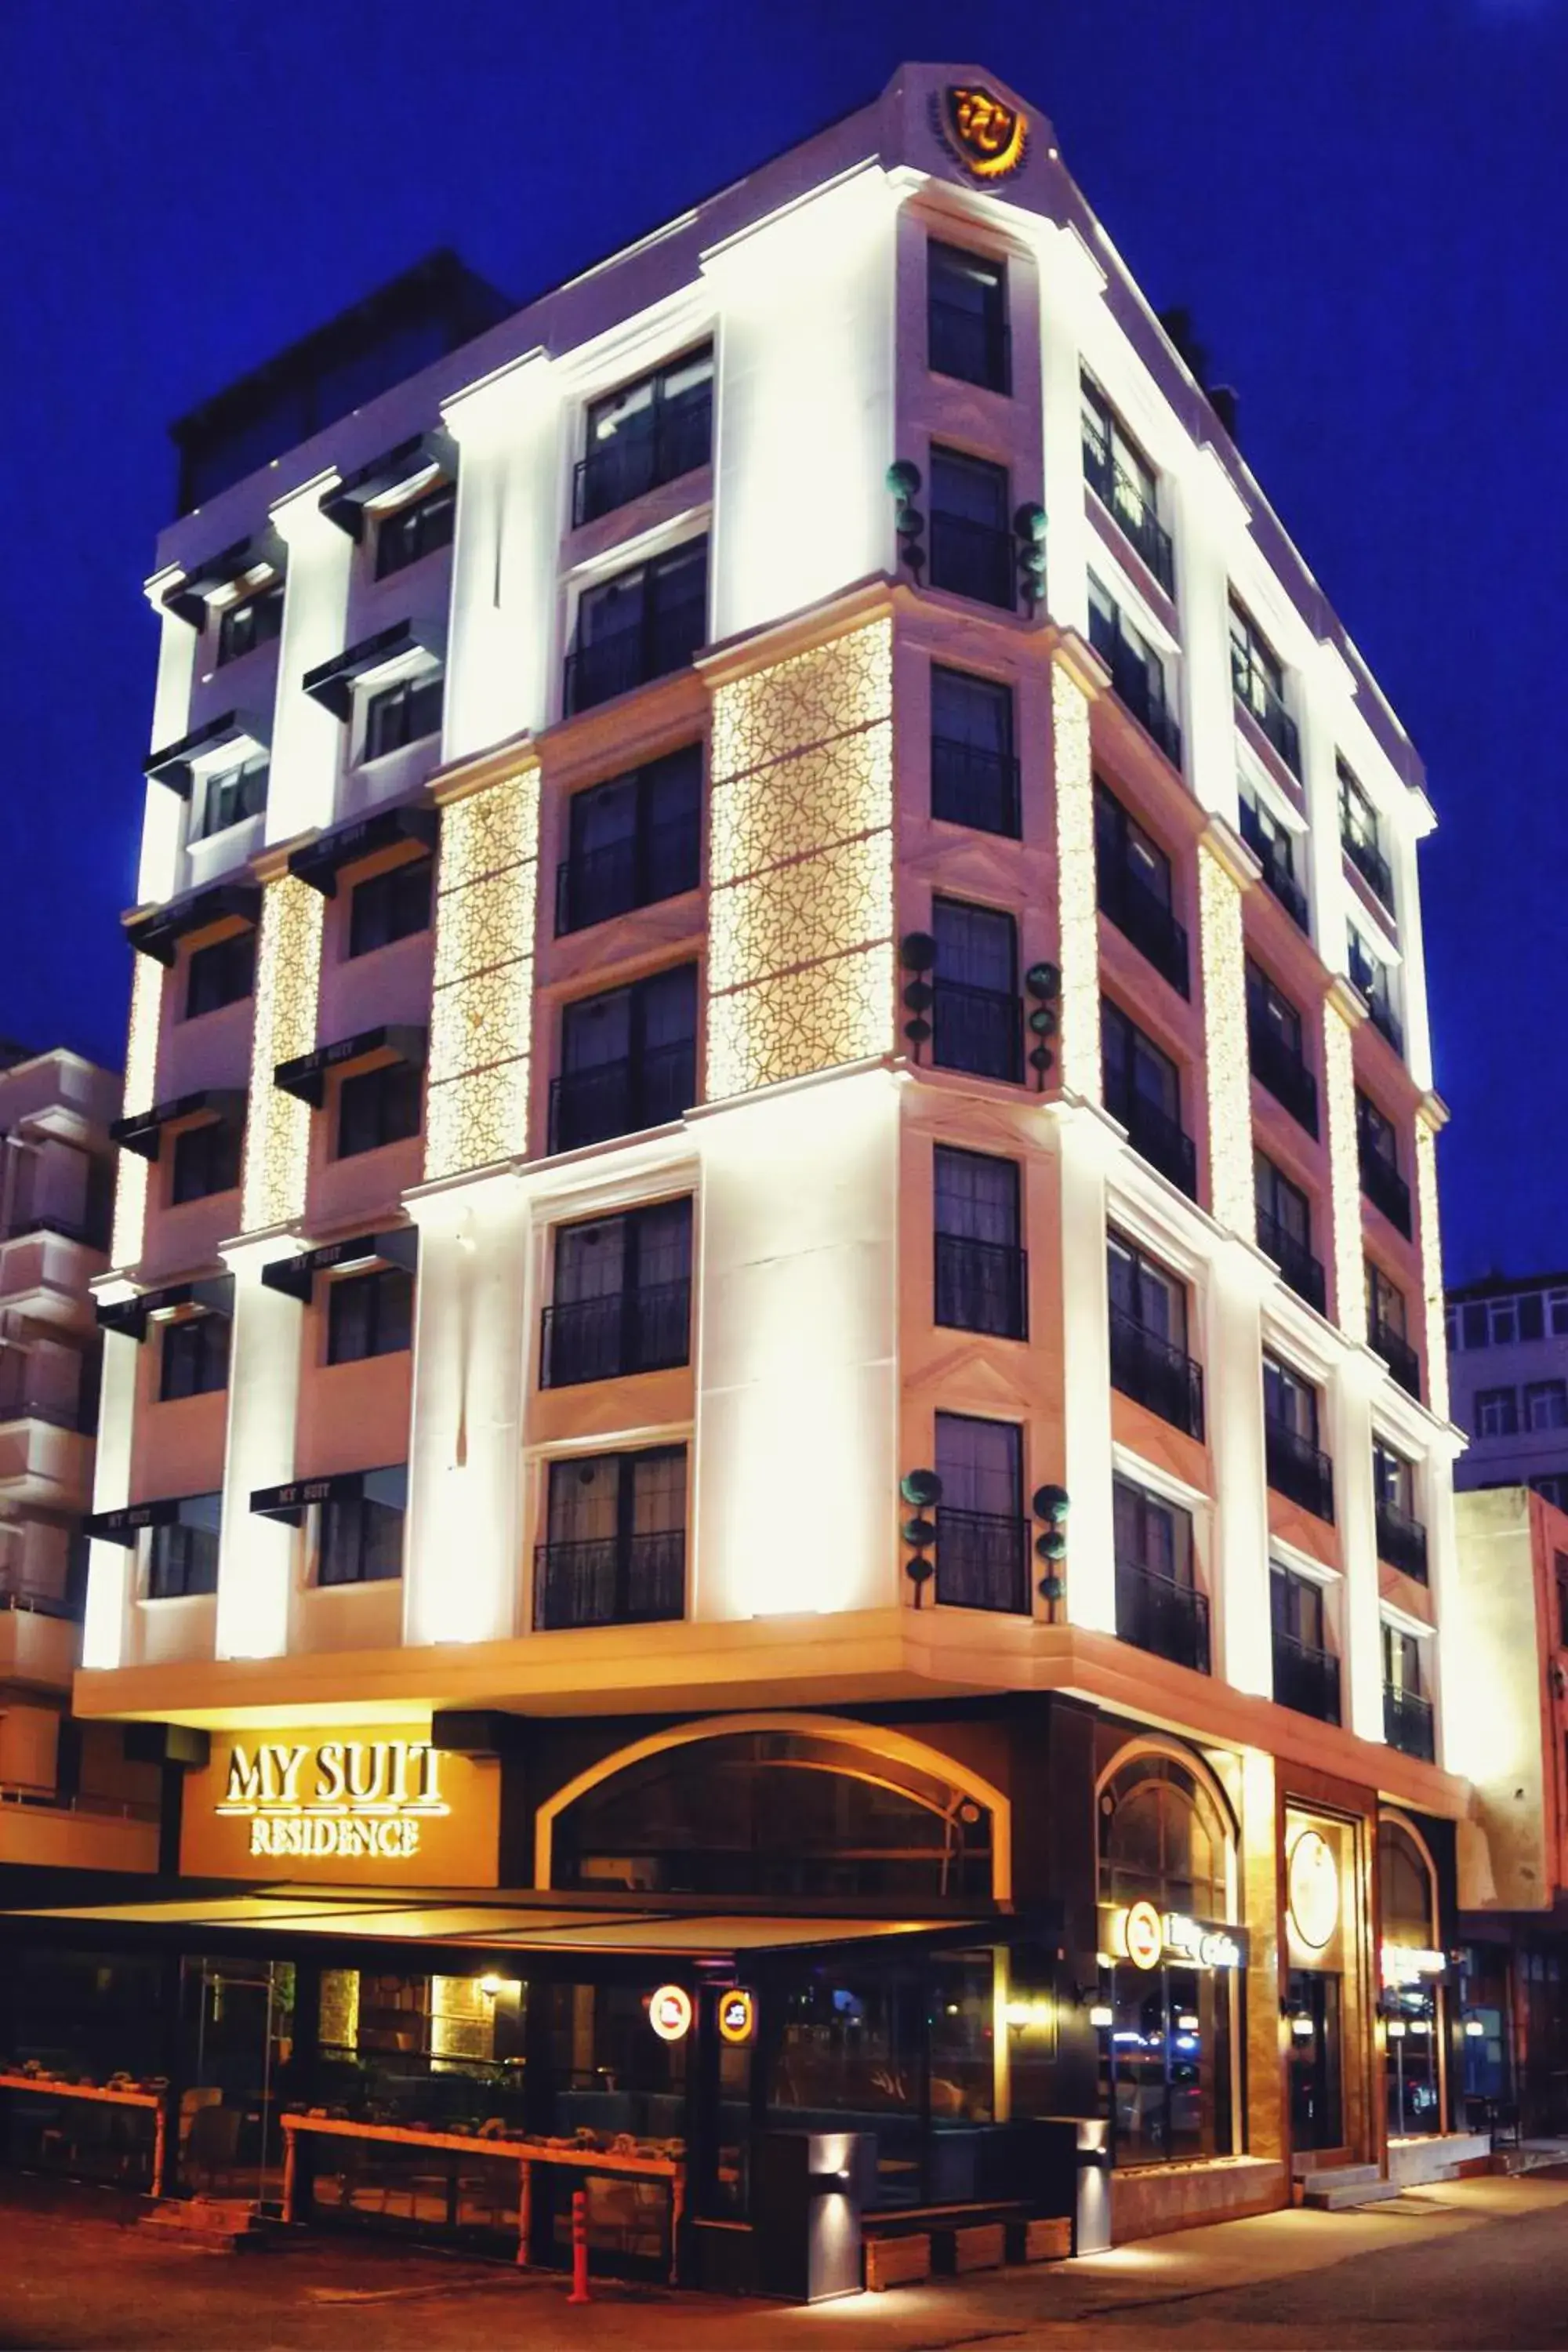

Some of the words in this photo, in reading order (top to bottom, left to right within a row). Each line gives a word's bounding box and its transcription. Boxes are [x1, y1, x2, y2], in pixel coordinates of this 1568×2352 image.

[227, 1744, 310, 1802] MY
[314, 1740, 449, 1802] SUIT
[249, 1817, 420, 1857] RESIDENCE
